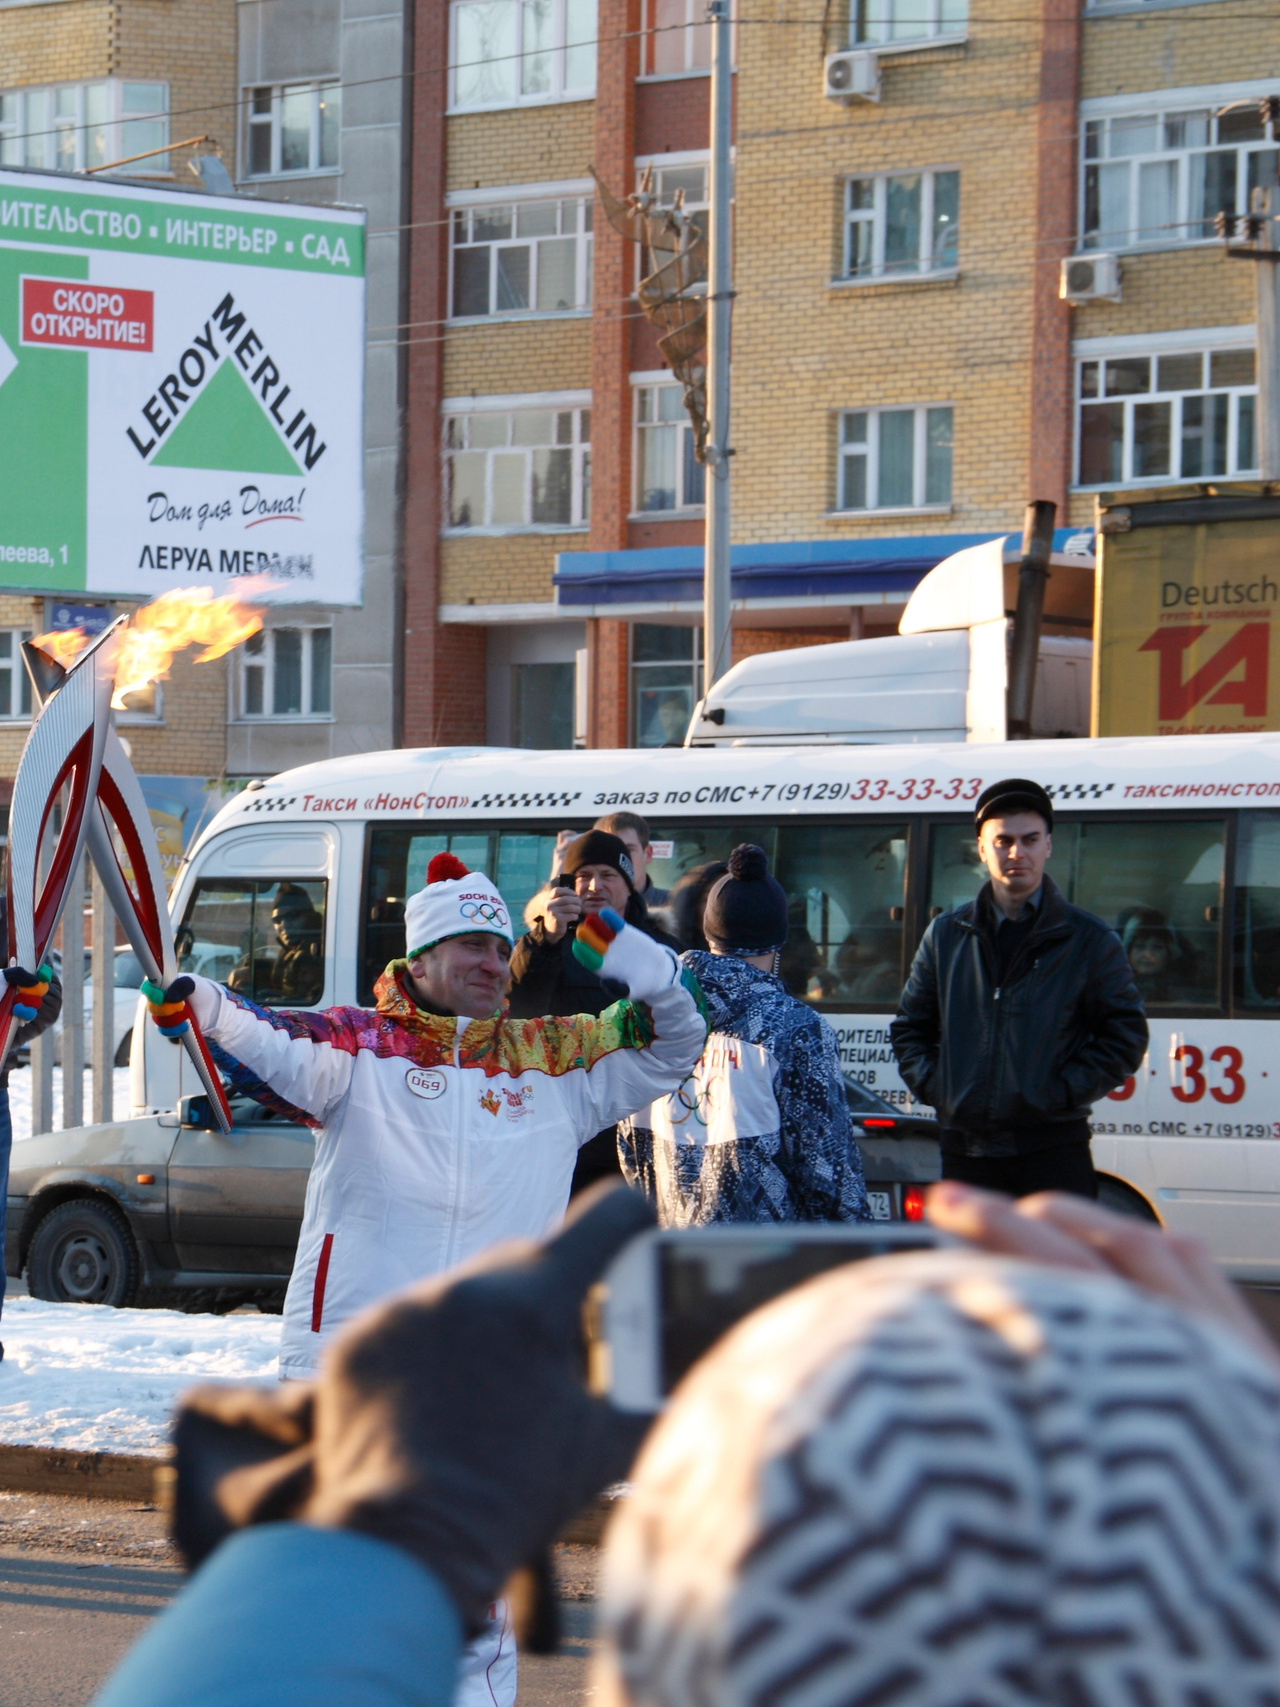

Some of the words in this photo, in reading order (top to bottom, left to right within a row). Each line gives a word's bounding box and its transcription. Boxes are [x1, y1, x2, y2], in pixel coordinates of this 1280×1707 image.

[166, 218, 278, 254] ИНТЕРЬЕР
[301, 234, 351, 267] САД
[53, 288, 124, 317] СКОРО
[31, 312, 146, 344] ОТКРЫТИЕ!
[126, 320, 220, 459] LEROY
[212, 292, 327, 471] MERLIN
[147, 492, 193, 523] Дом
[197, 499, 233, 531] для
[239, 485, 306, 516] Дома!
[59, 545, 69, 564] 1
[138, 545, 214, 572] ЛЕРУА
[1162, 574, 1280, 607] Deutsch
[302, 794, 358, 812] Такси
[363, 792, 469, 811] «НонСтоп»
[593, 790, 658, 806] заказ
[664, 789, 691, 804] по
[459, 893, 488, 901] SOCHI
[411, 1076, 440, 1091] 069
[1123, 1123, 1143, 1135] по
[1148, 1121, 1187, 1135] СМС
